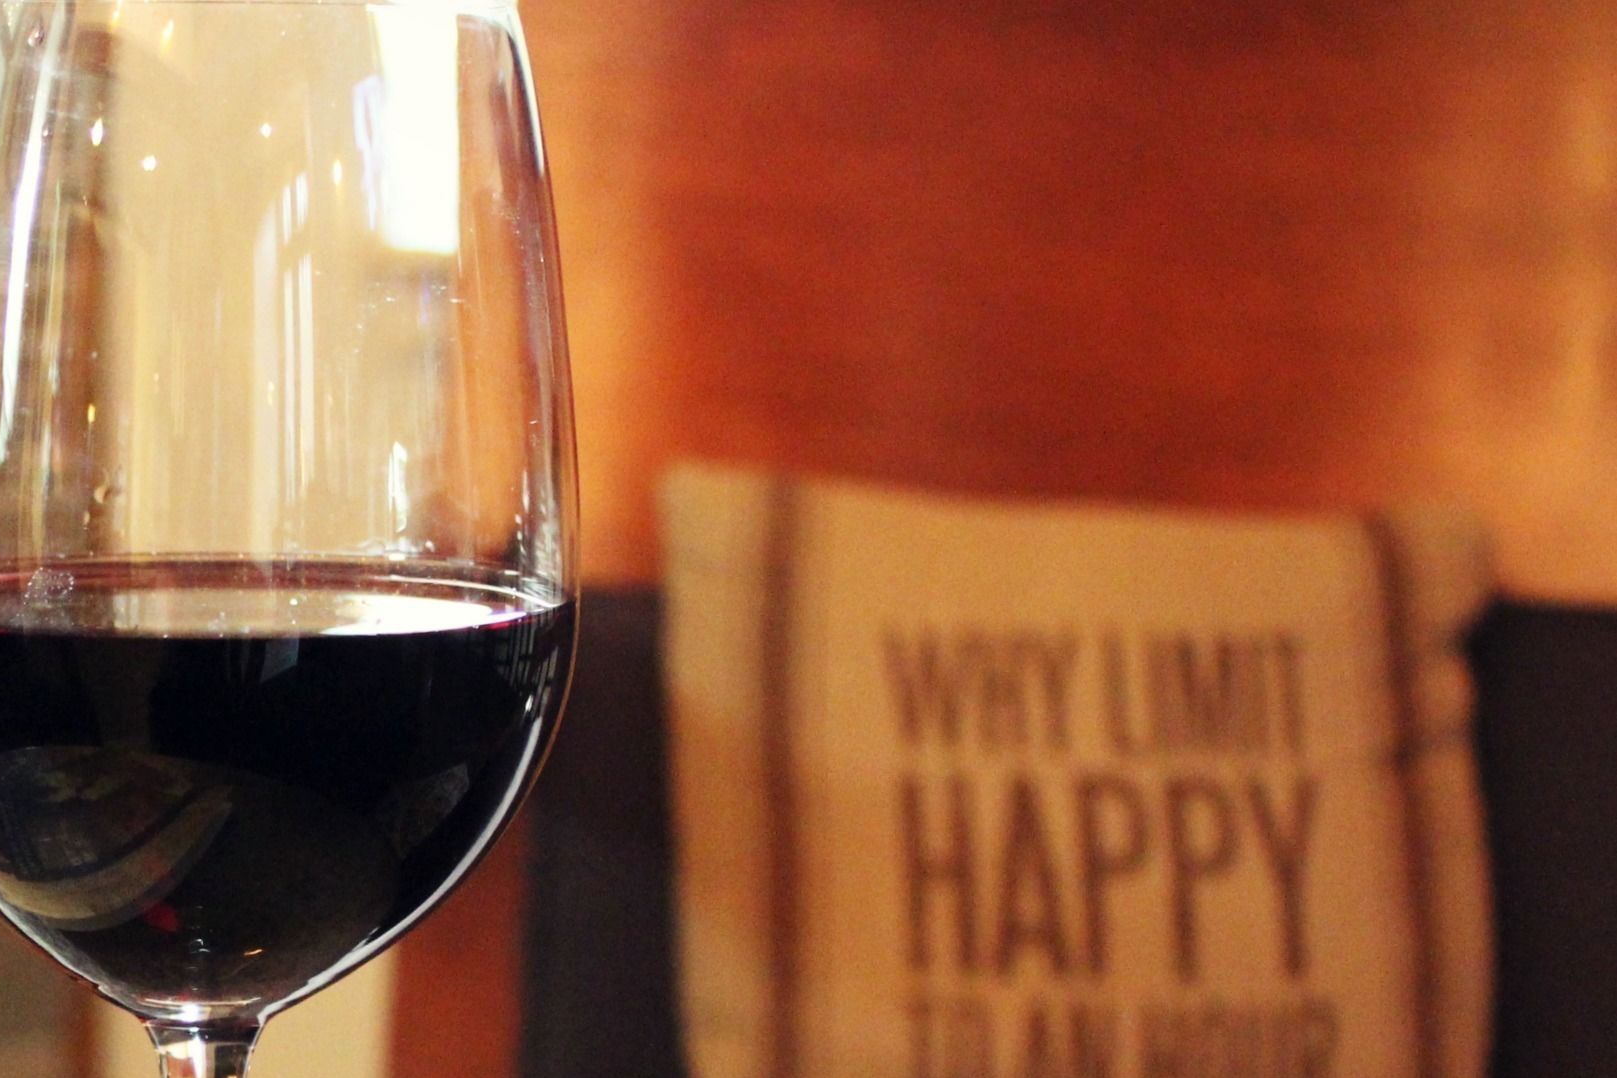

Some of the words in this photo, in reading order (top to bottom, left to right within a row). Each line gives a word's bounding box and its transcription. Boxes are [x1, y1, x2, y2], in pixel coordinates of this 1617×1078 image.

[880, 620, 1086, 750] WHY
[1098, 626, 1310, 756] LIMIT
[896, 770, 1322, 982] HAPPY
